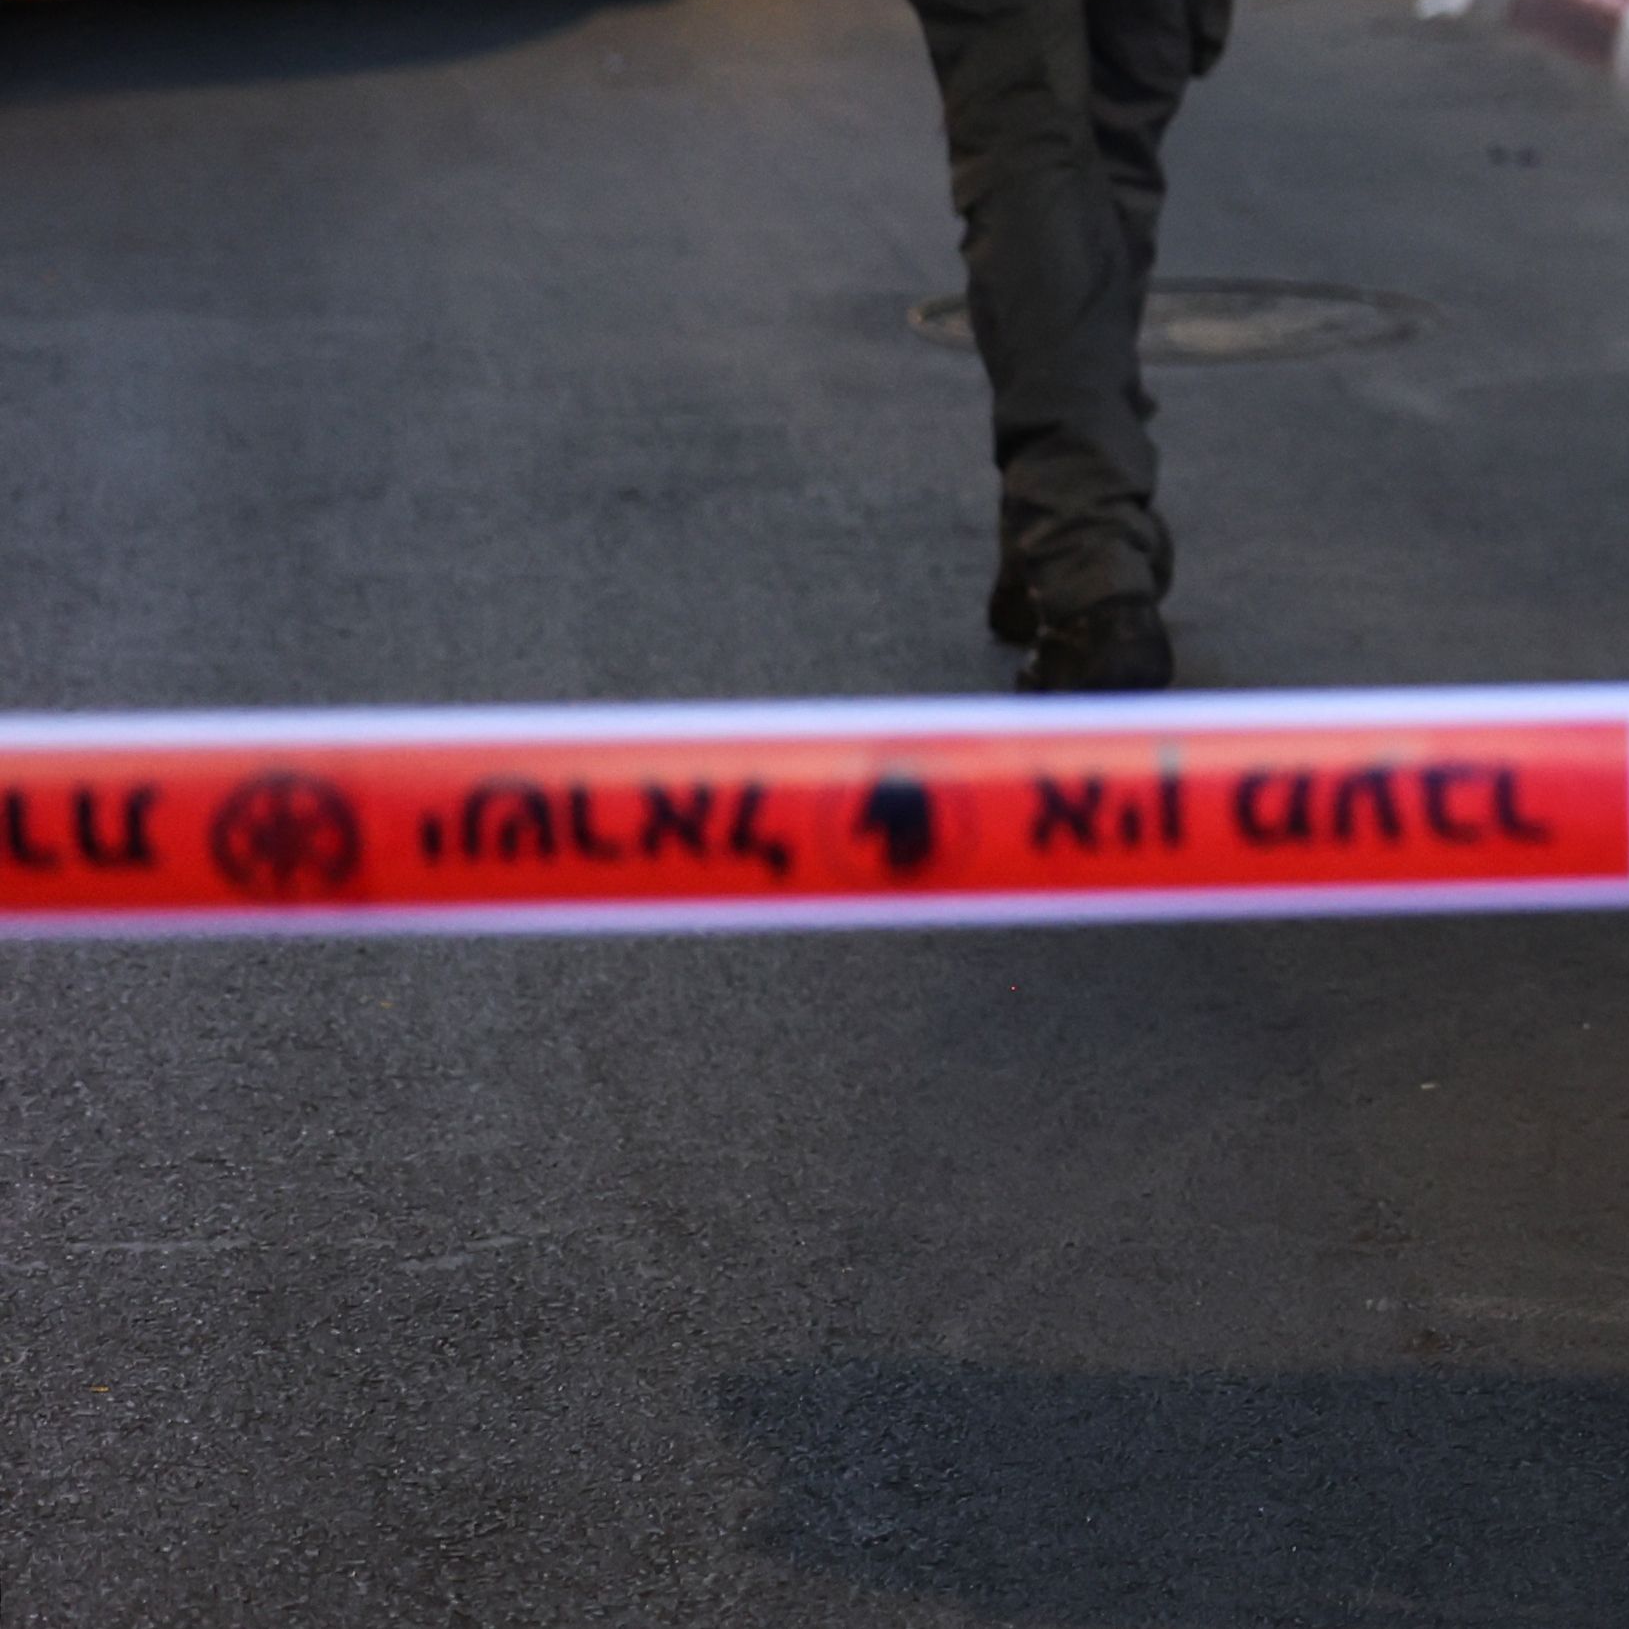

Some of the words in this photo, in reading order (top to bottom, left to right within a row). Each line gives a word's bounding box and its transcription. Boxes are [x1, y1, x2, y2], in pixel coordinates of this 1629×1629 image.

[419, 777, 791, 879] ישראל
[1032, 741, 1189, 859] אין
[1232, 760, 1545, 851] מעבר
